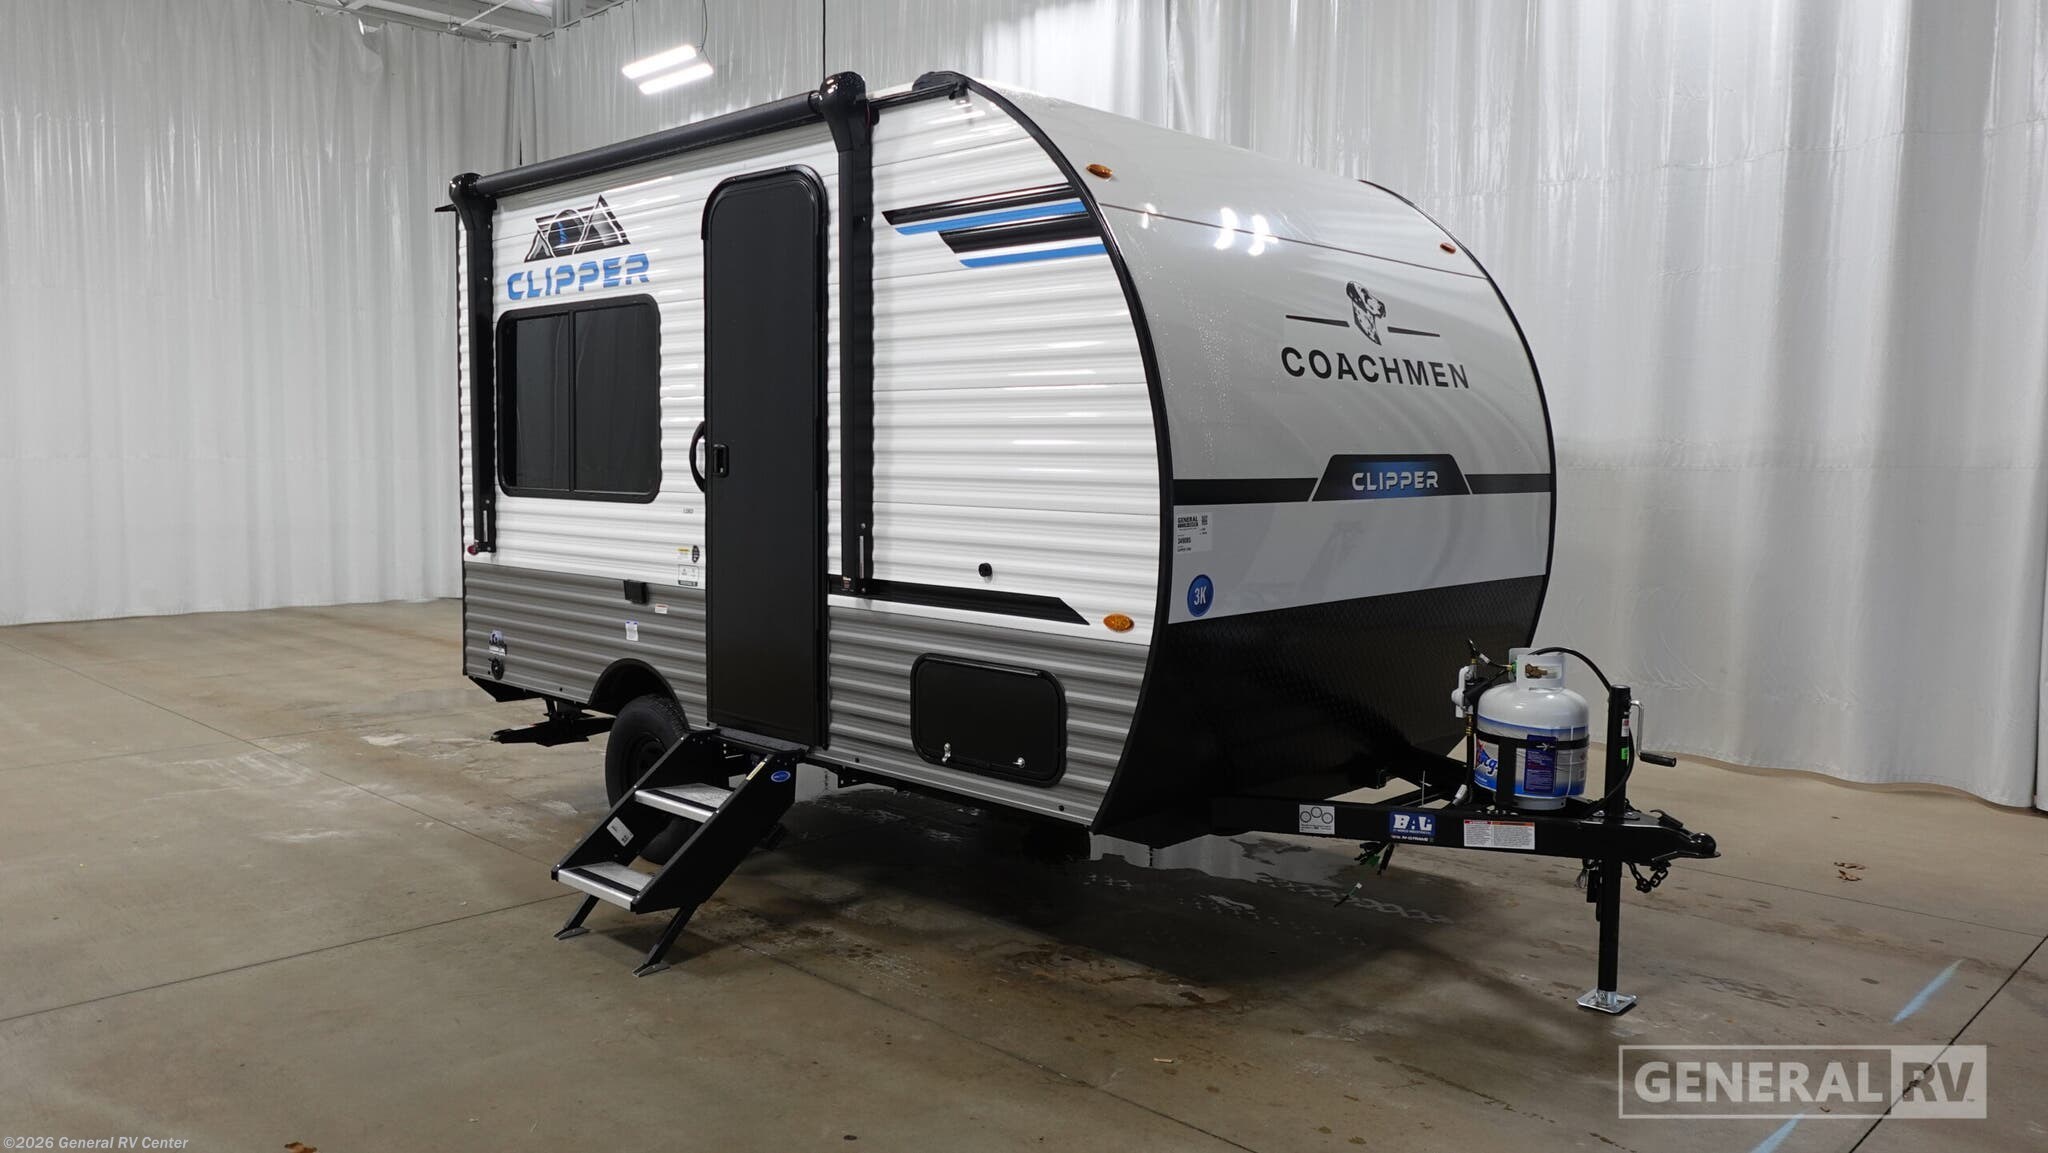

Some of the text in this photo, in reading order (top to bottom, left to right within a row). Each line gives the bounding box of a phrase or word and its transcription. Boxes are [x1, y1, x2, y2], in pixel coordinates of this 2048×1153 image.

[507, 253, 650, 301] CLIPPER
[1281, 347, 1470, 389] COACHMEN
[1352, 471, 1439, 491] CLIPPER
[1193, 586, 1208, 606] 3K
